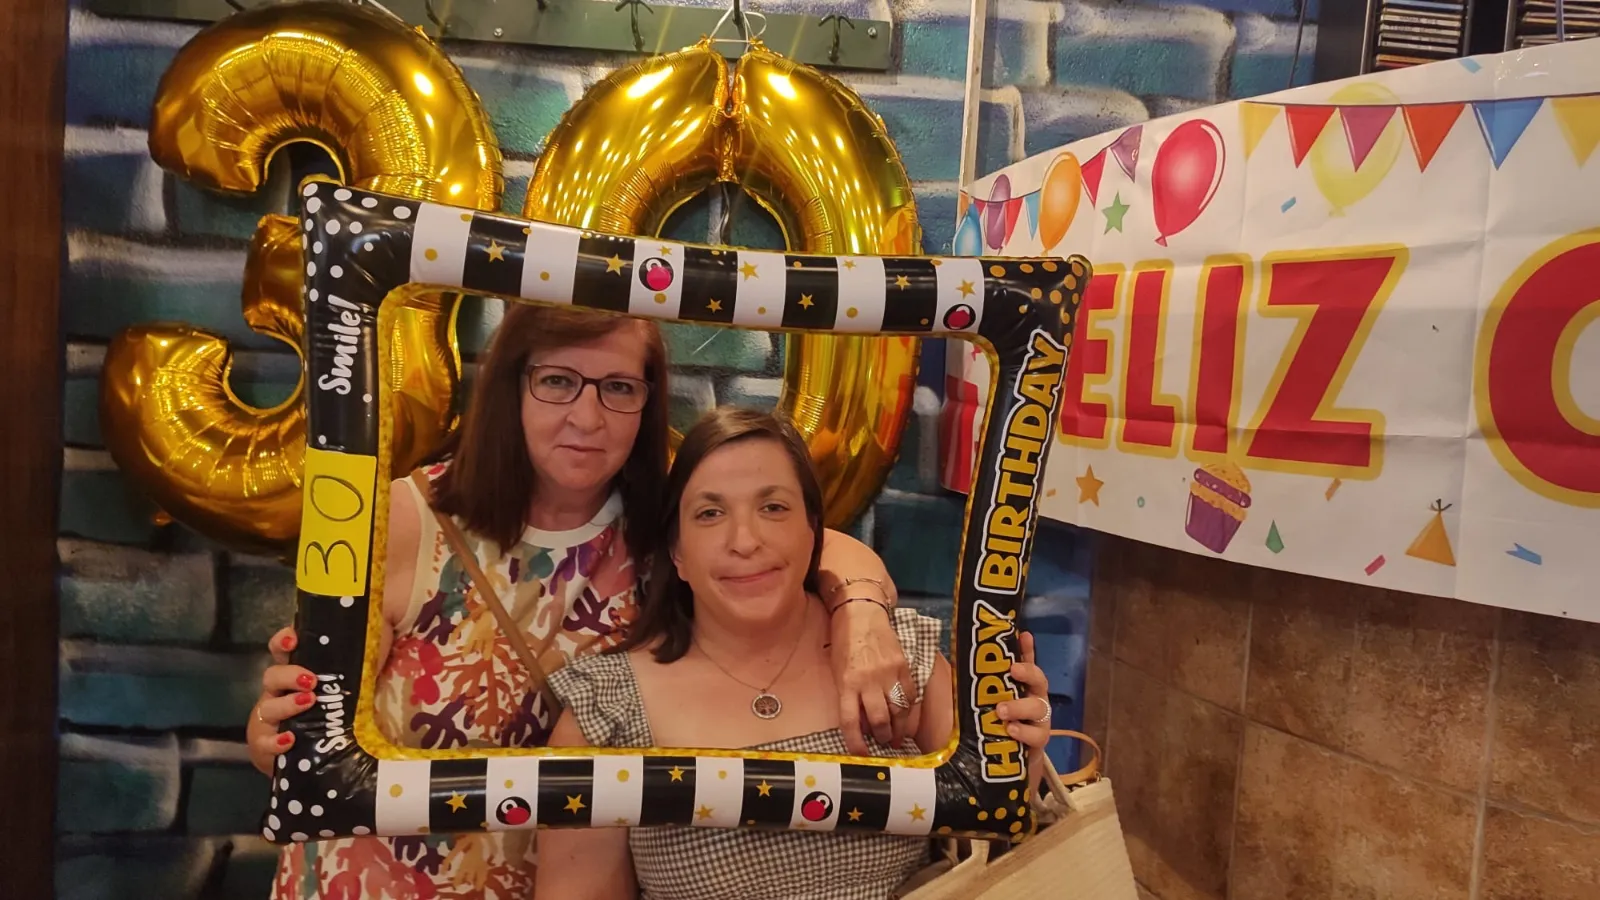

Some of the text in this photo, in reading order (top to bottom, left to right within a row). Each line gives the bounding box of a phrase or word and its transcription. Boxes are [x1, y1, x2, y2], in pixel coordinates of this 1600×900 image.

[318, 294, 361, 395] Smile!
[1057, 243, 1410, 481] ELIZ
[304, 475, 365, 583] 30
[971, 330, 1067, 782] HAPPY BIRTHDAY
[315, 674, 345, 754] Smile!
